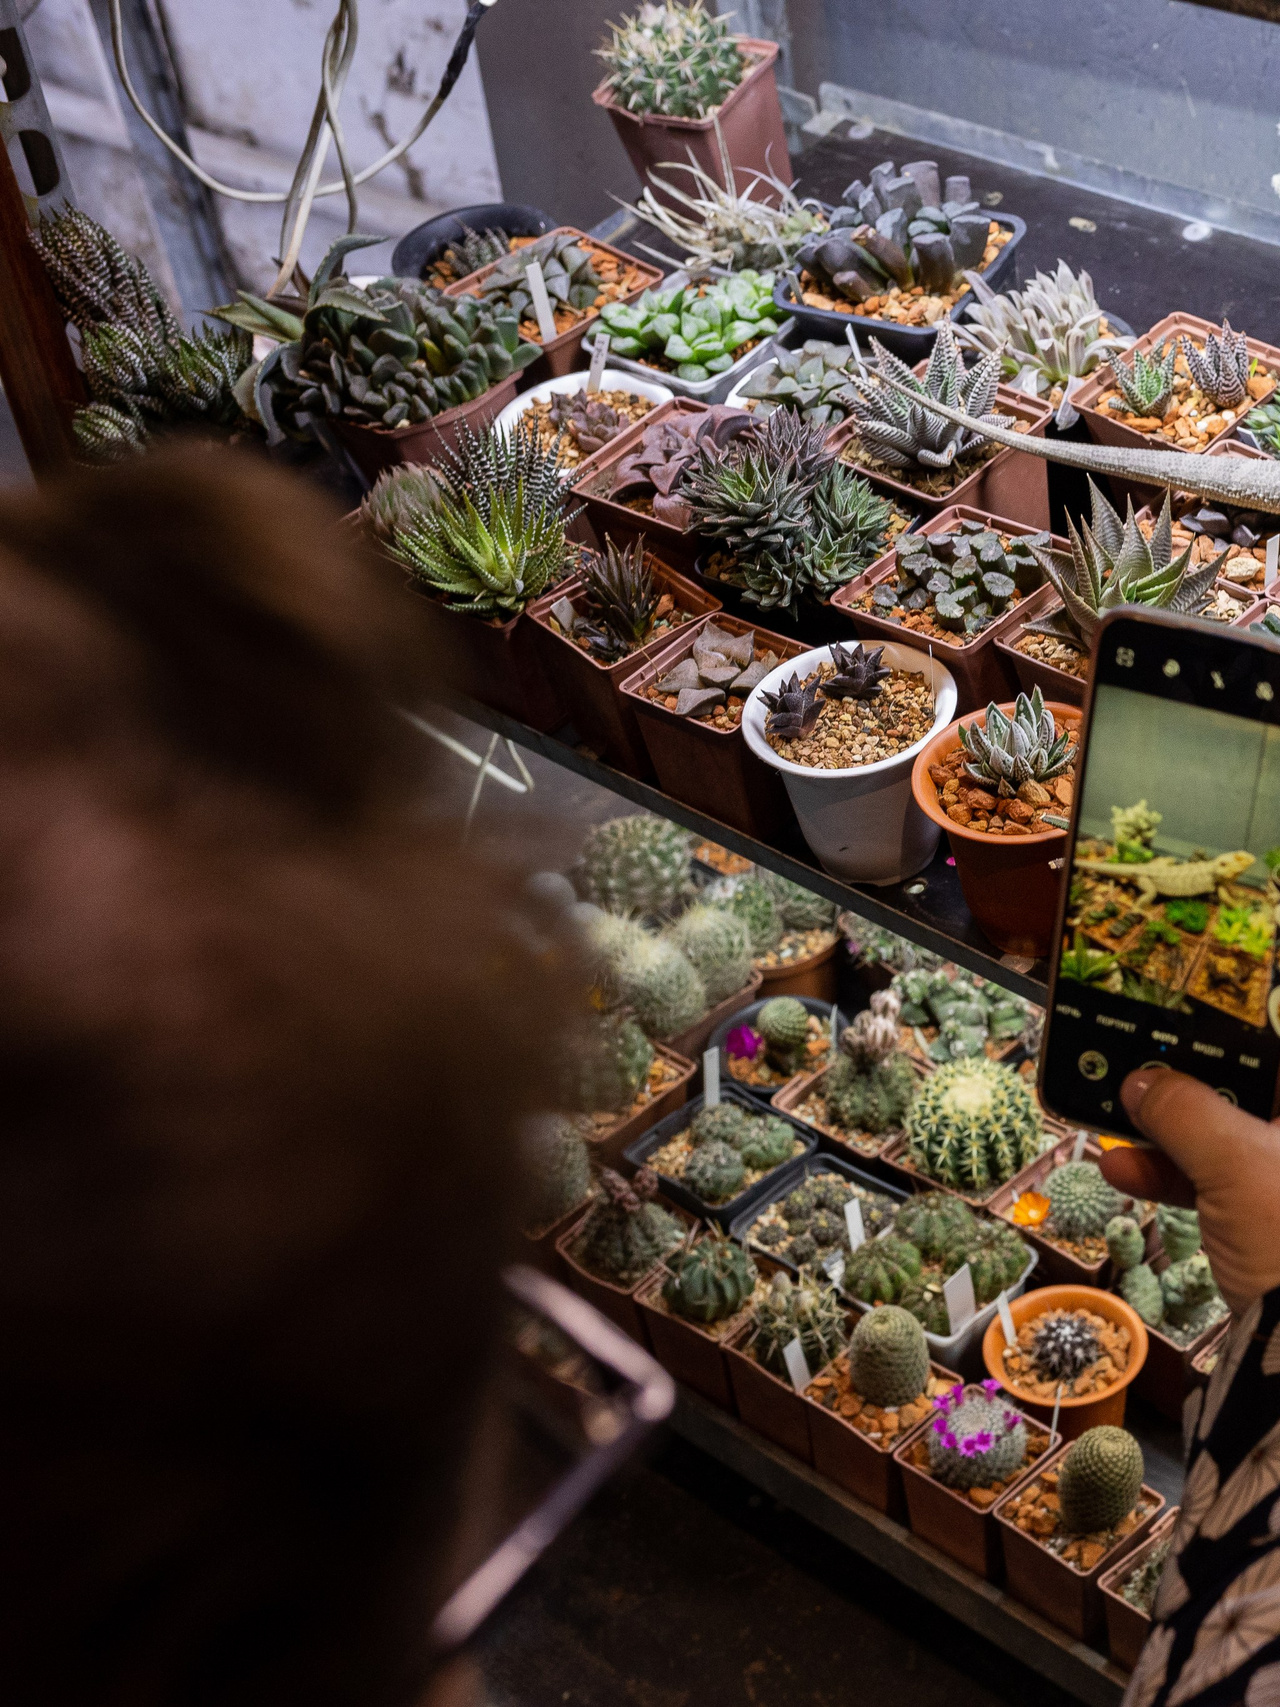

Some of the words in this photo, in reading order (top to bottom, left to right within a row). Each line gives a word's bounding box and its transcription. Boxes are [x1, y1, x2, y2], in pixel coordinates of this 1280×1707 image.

[1096, 1013, 1136, 1033] ПОРТРЕТ
[1151, 1029, 1179, 1046] ФОТО
[1192, 1040, 1225, 1059] ВИДЕО
